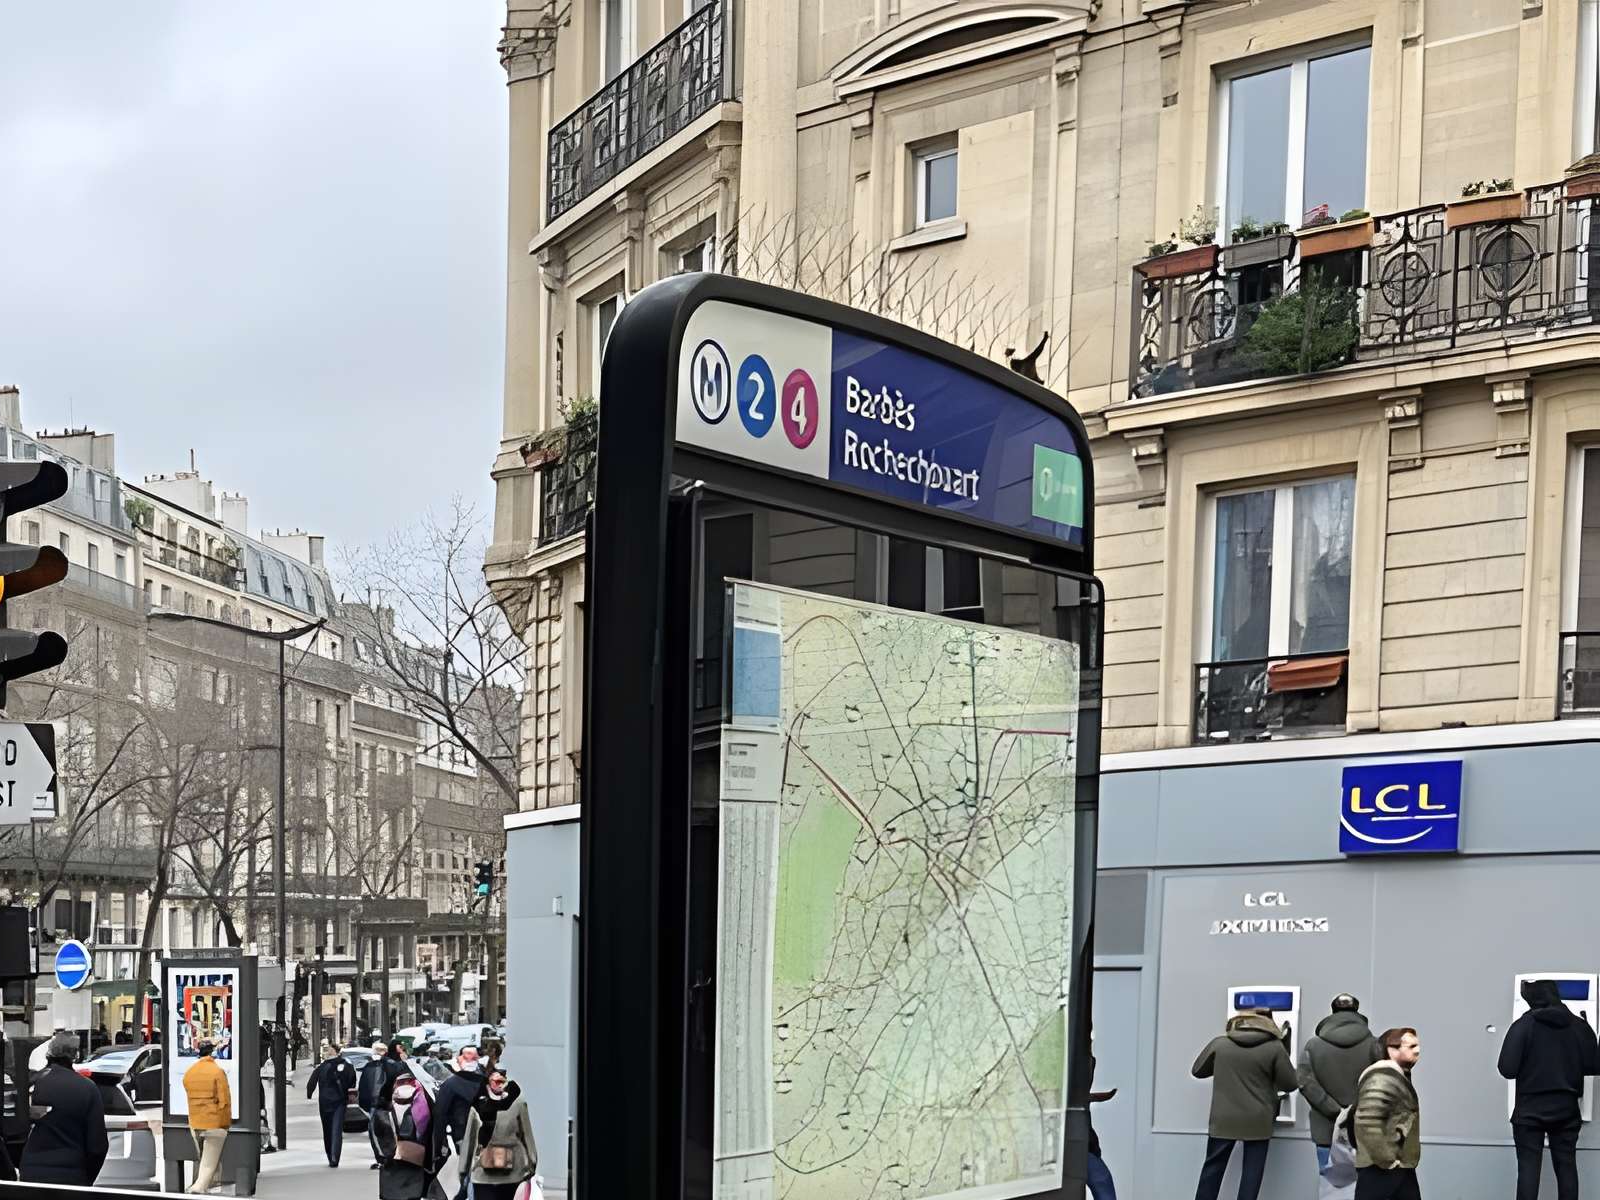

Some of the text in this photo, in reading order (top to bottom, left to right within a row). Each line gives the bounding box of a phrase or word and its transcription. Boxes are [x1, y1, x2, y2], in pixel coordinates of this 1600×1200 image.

[748, 371, 765, 421] 2
[791, 386, 808, 436] 4
[846, 375, 916, 432] Barbès
[1351, 783, 1447, 814] LCL
